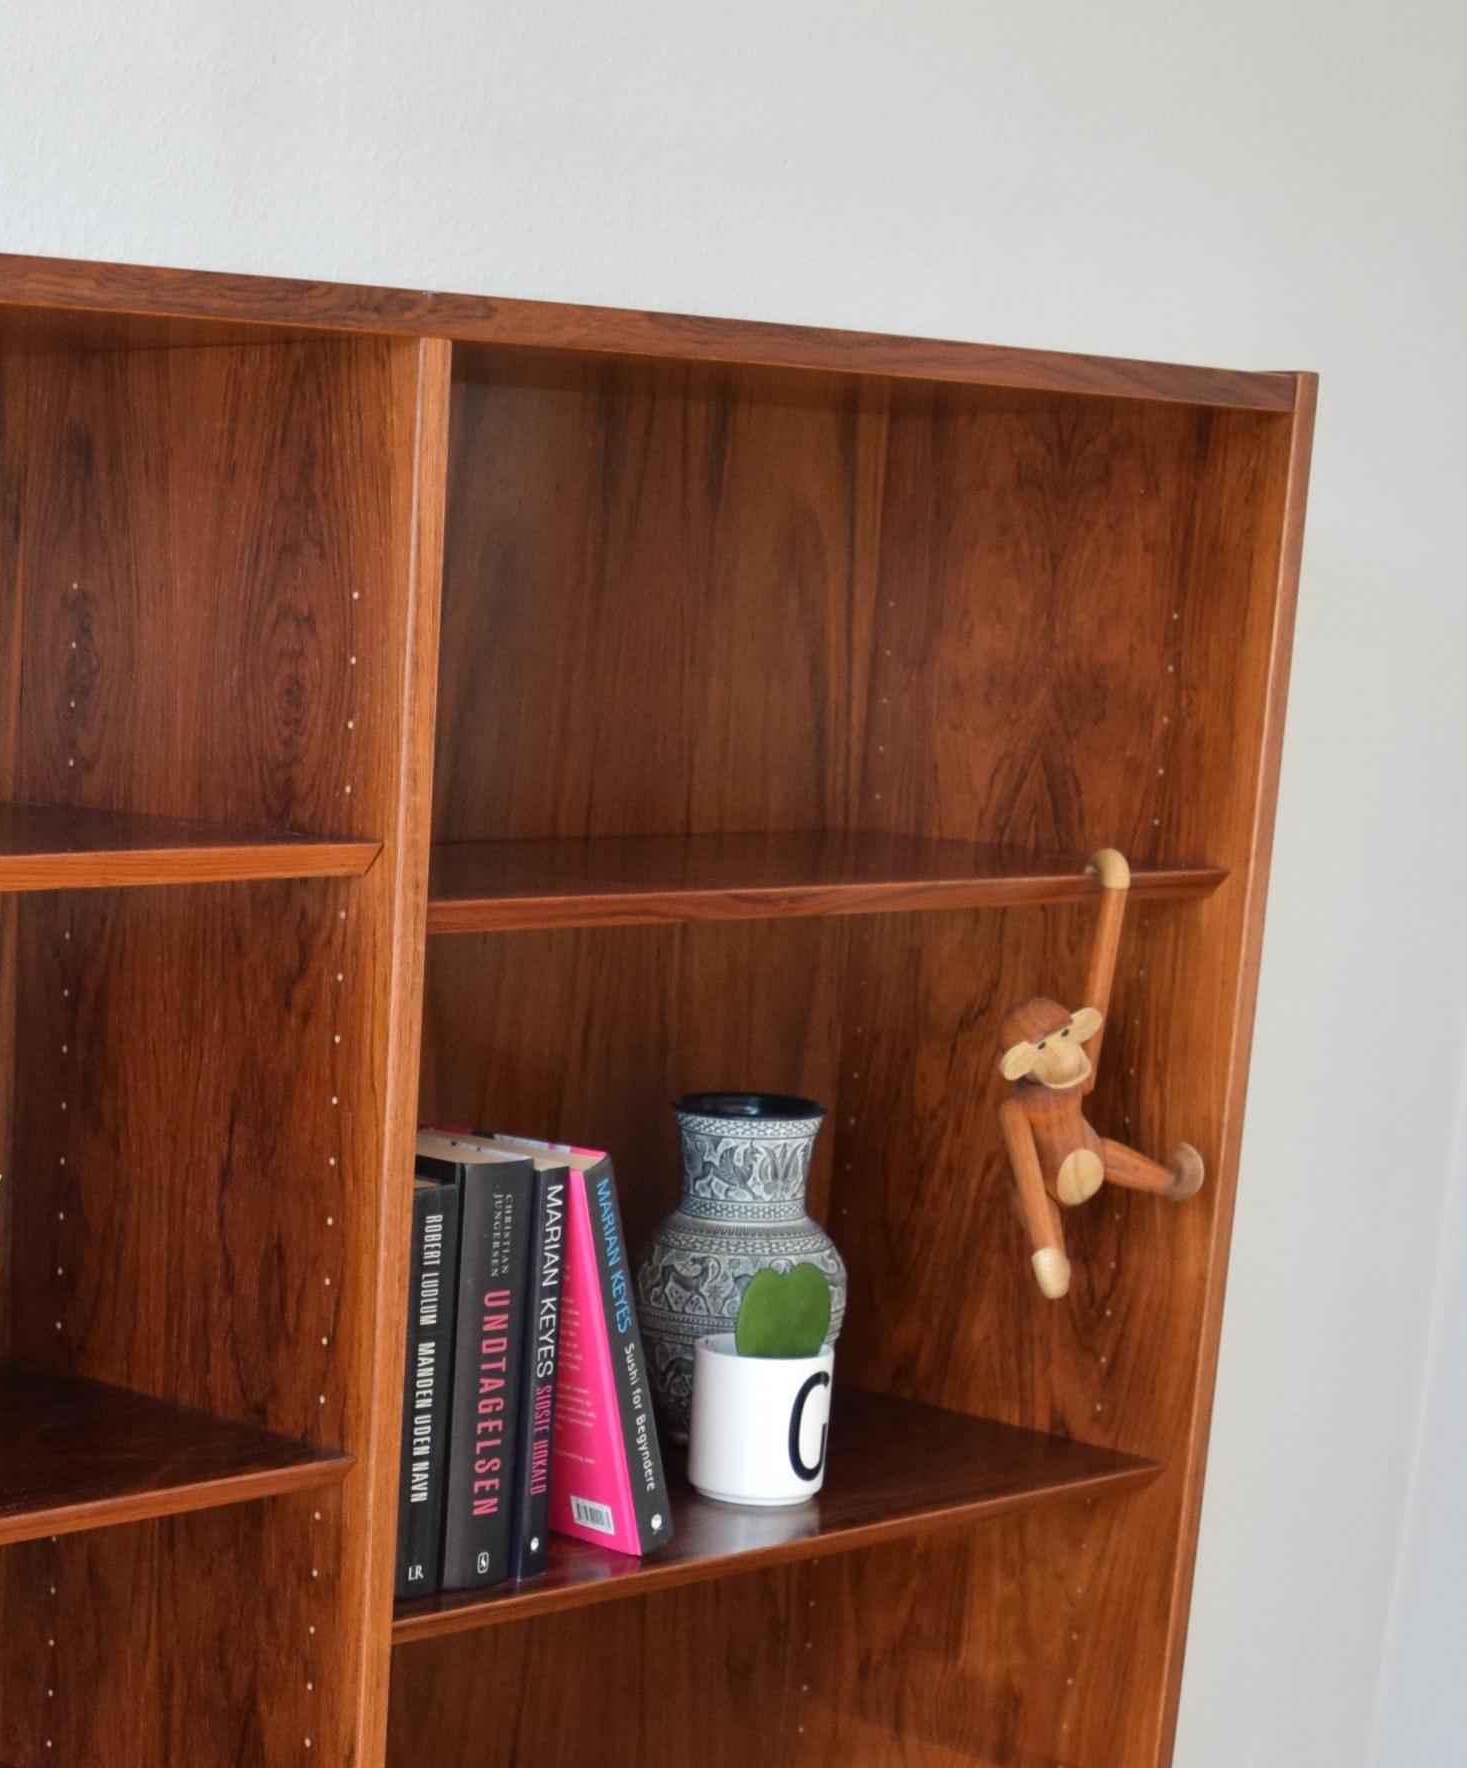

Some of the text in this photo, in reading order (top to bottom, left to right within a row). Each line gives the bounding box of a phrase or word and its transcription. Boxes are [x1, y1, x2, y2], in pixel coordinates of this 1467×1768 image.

[419, 1214, 444, 1326] ROBERT LUDLUM
[491, 1193, 504, 1278] JUNGERSEN
[501, 1193, 513, 1275] CHRISTIAN
[536, 1184, 564, 1378] MARIAN KEYES
[596, 1177, 632, 1334] MARIAN KEYES
[410, 1341, 436, 1503] MANDEN UDEN NAVN
[471, 1288, 512, 1516] UNDTAGELSEN
[625, 1343, 655, 1492] Sushi for Begyndere
[408, 1564, 425, 1581] LR
